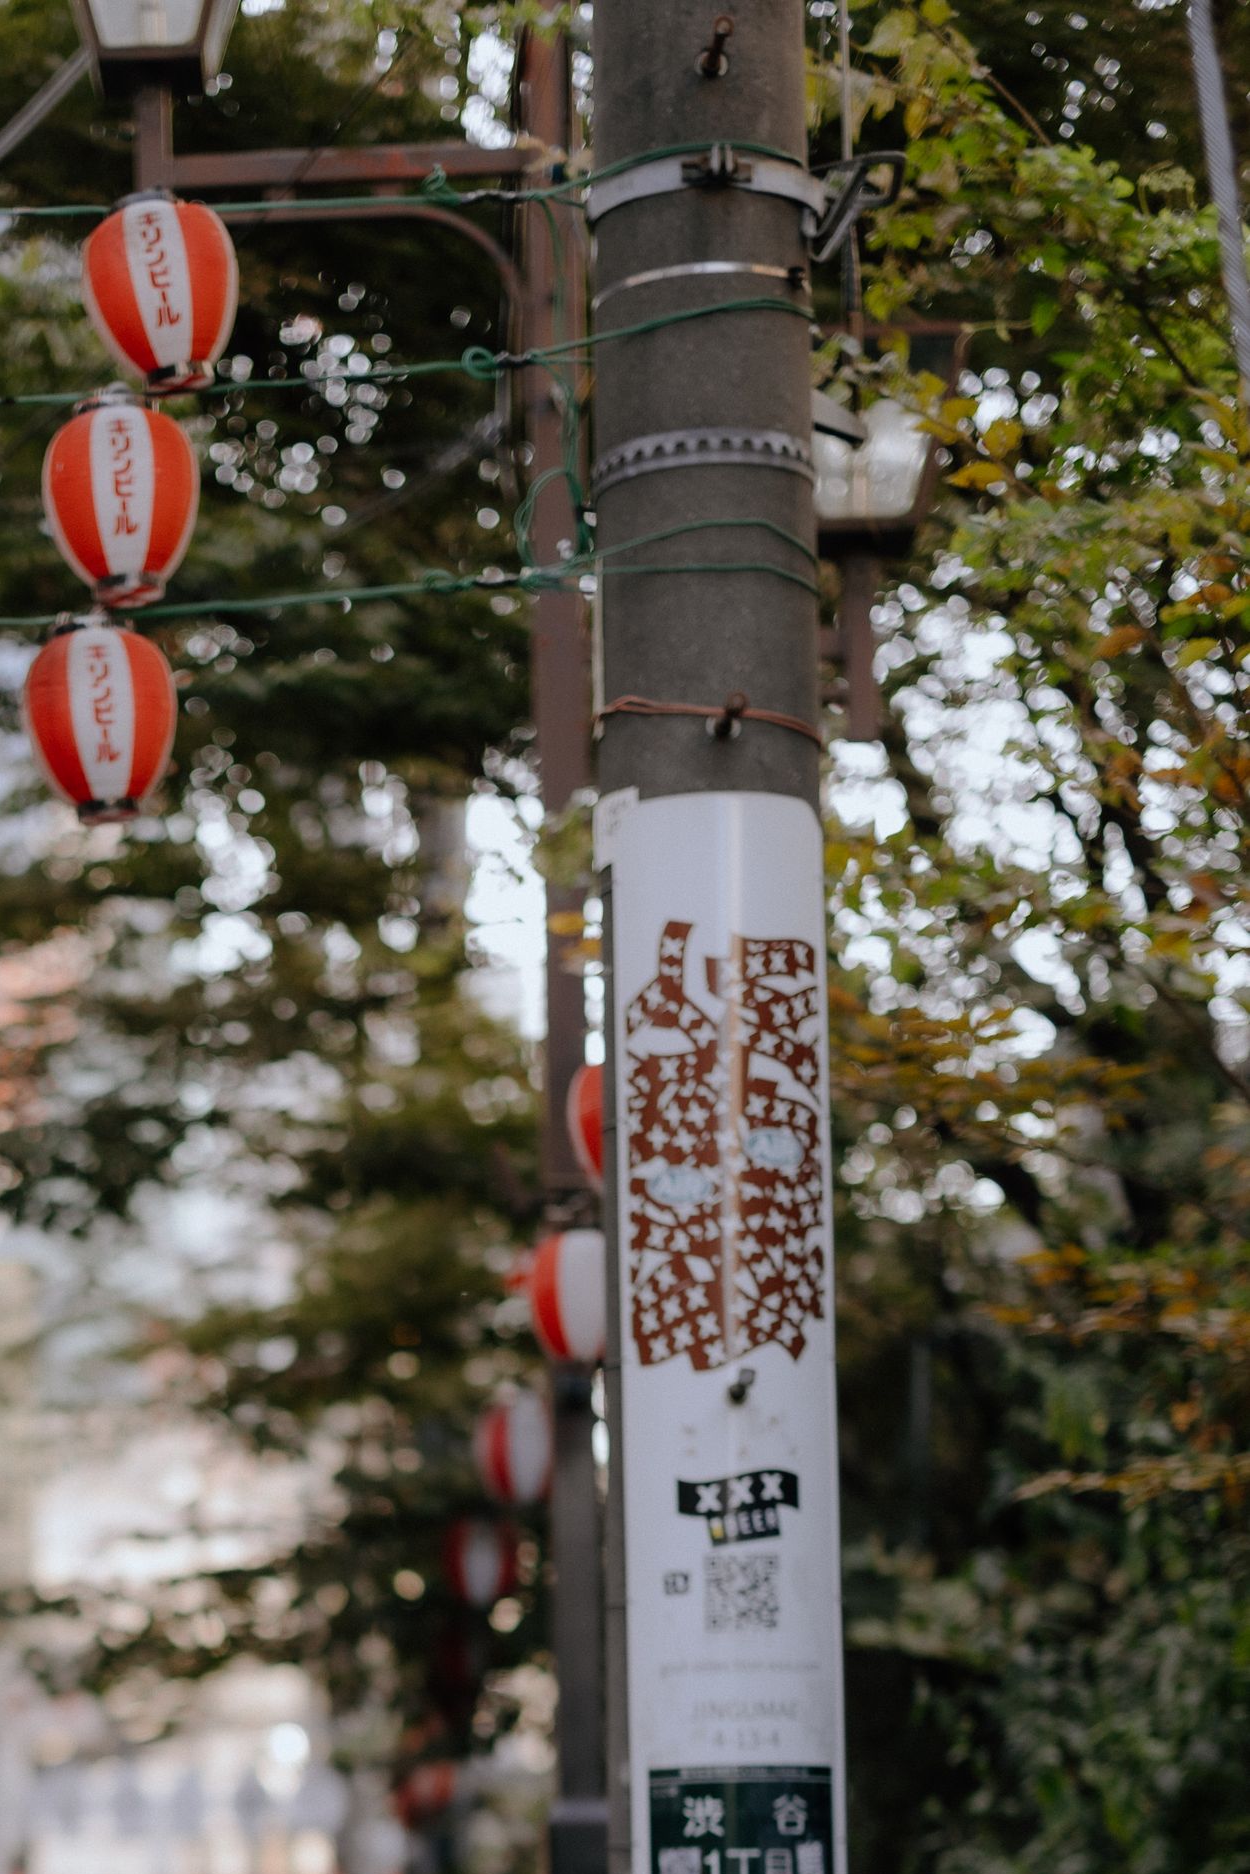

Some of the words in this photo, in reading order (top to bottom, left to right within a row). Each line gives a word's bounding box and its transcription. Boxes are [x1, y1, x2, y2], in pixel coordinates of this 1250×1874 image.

[137, 213, 183, 329] キリンビール
[107, 418, 140, 537] キリンビール
[87, 644, 122, 764] キリンビール
